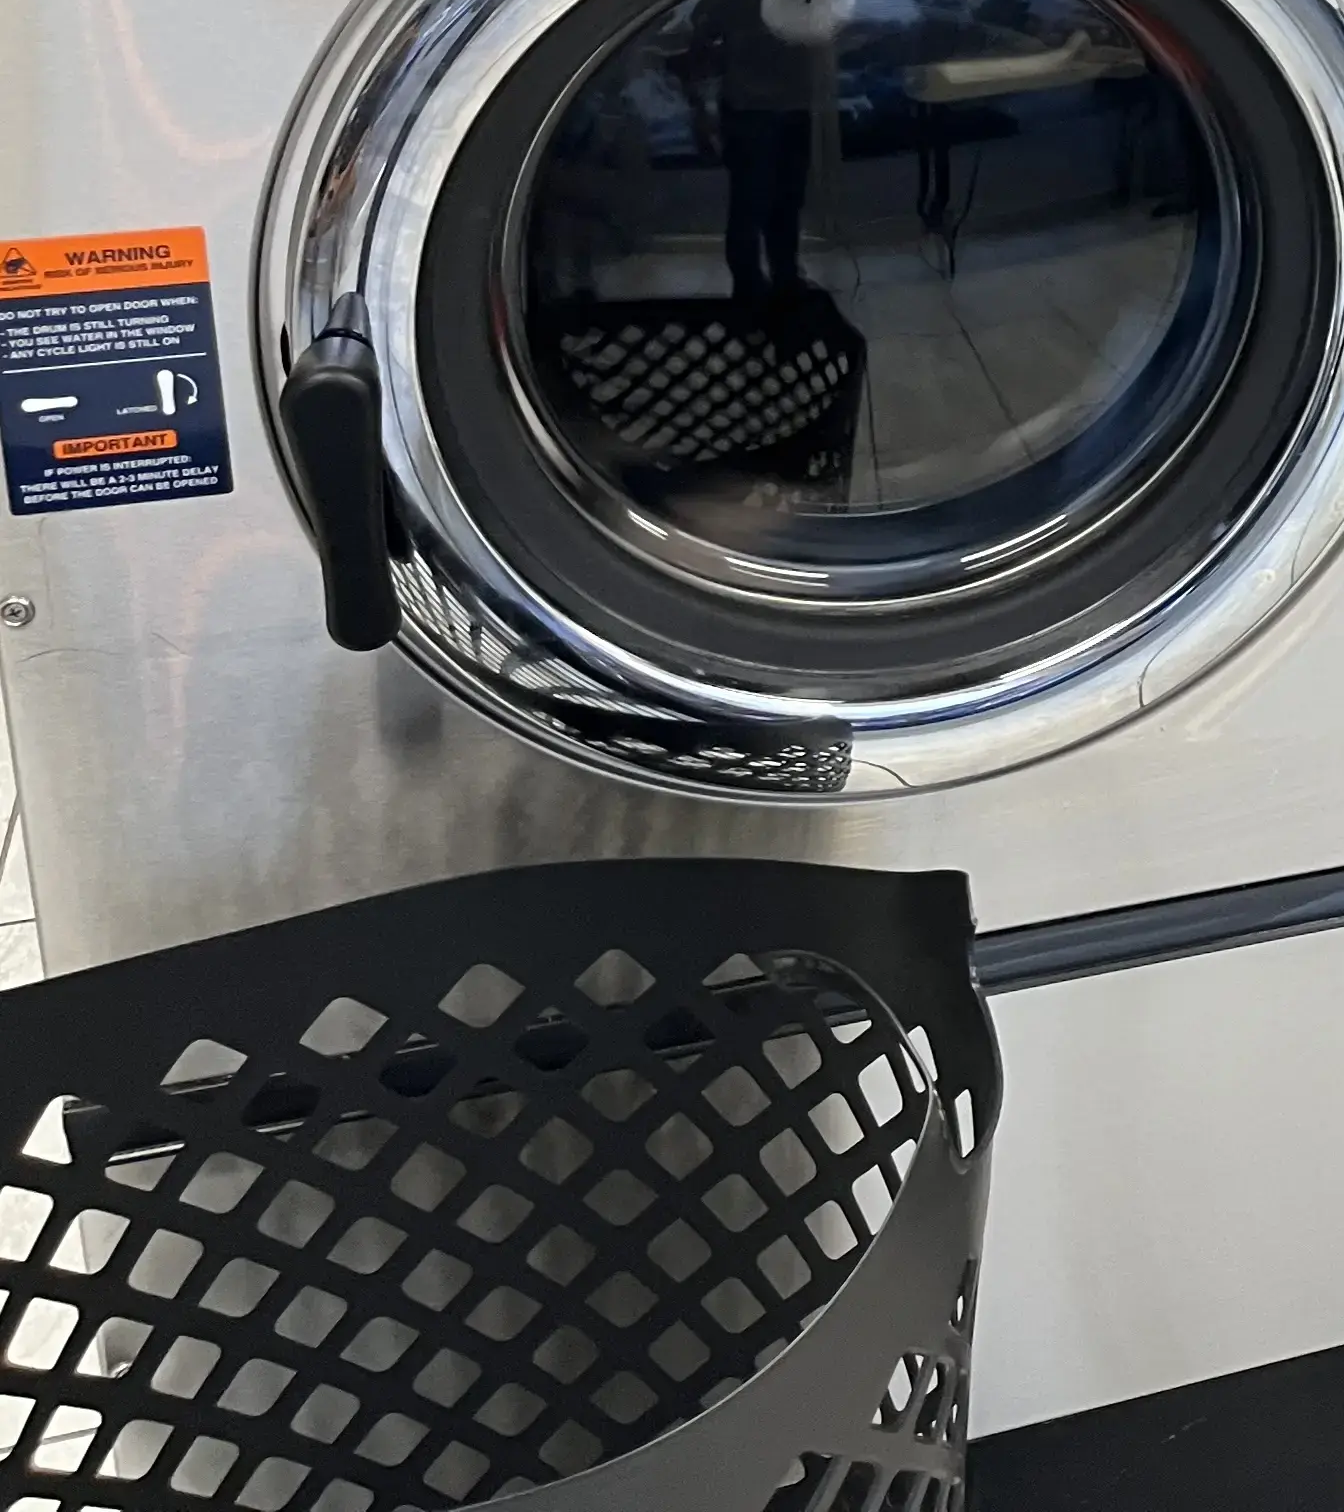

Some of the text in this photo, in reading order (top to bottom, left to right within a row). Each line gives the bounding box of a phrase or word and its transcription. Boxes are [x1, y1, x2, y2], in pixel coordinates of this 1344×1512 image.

[64, 244, 171, 266] WARNING
[0, 311, 16, 320] DO
[17, 308, 42, 319] NOT
[44, 307, 68, 316] TRY
[70, 304, 86, 314] TO
[88, 302, 122, 313] OPEN
[124, 299, 158, 310] DOOR
[6, 314, 170, 337] THE DRUM IS STILL TURNING
[8, 323, 196, 348] YOU SEE WATER IN THE WINDOW
[10, 336, 180, 360] ANY CYCLE LIGHT IS STILL ON
[62, 432, 168, 454] IMPORTANT
[20, 465, 218, 493] THERE WILL BE A 2-3 MINUTE DELAY
[44, 468, 54, 478] IF
[56, 464, 98, 476] POWER
[99, 462, 111, 472] IS
[24, 476, 218, 504] BEFORE THE DOOR CAN BE OPENED
